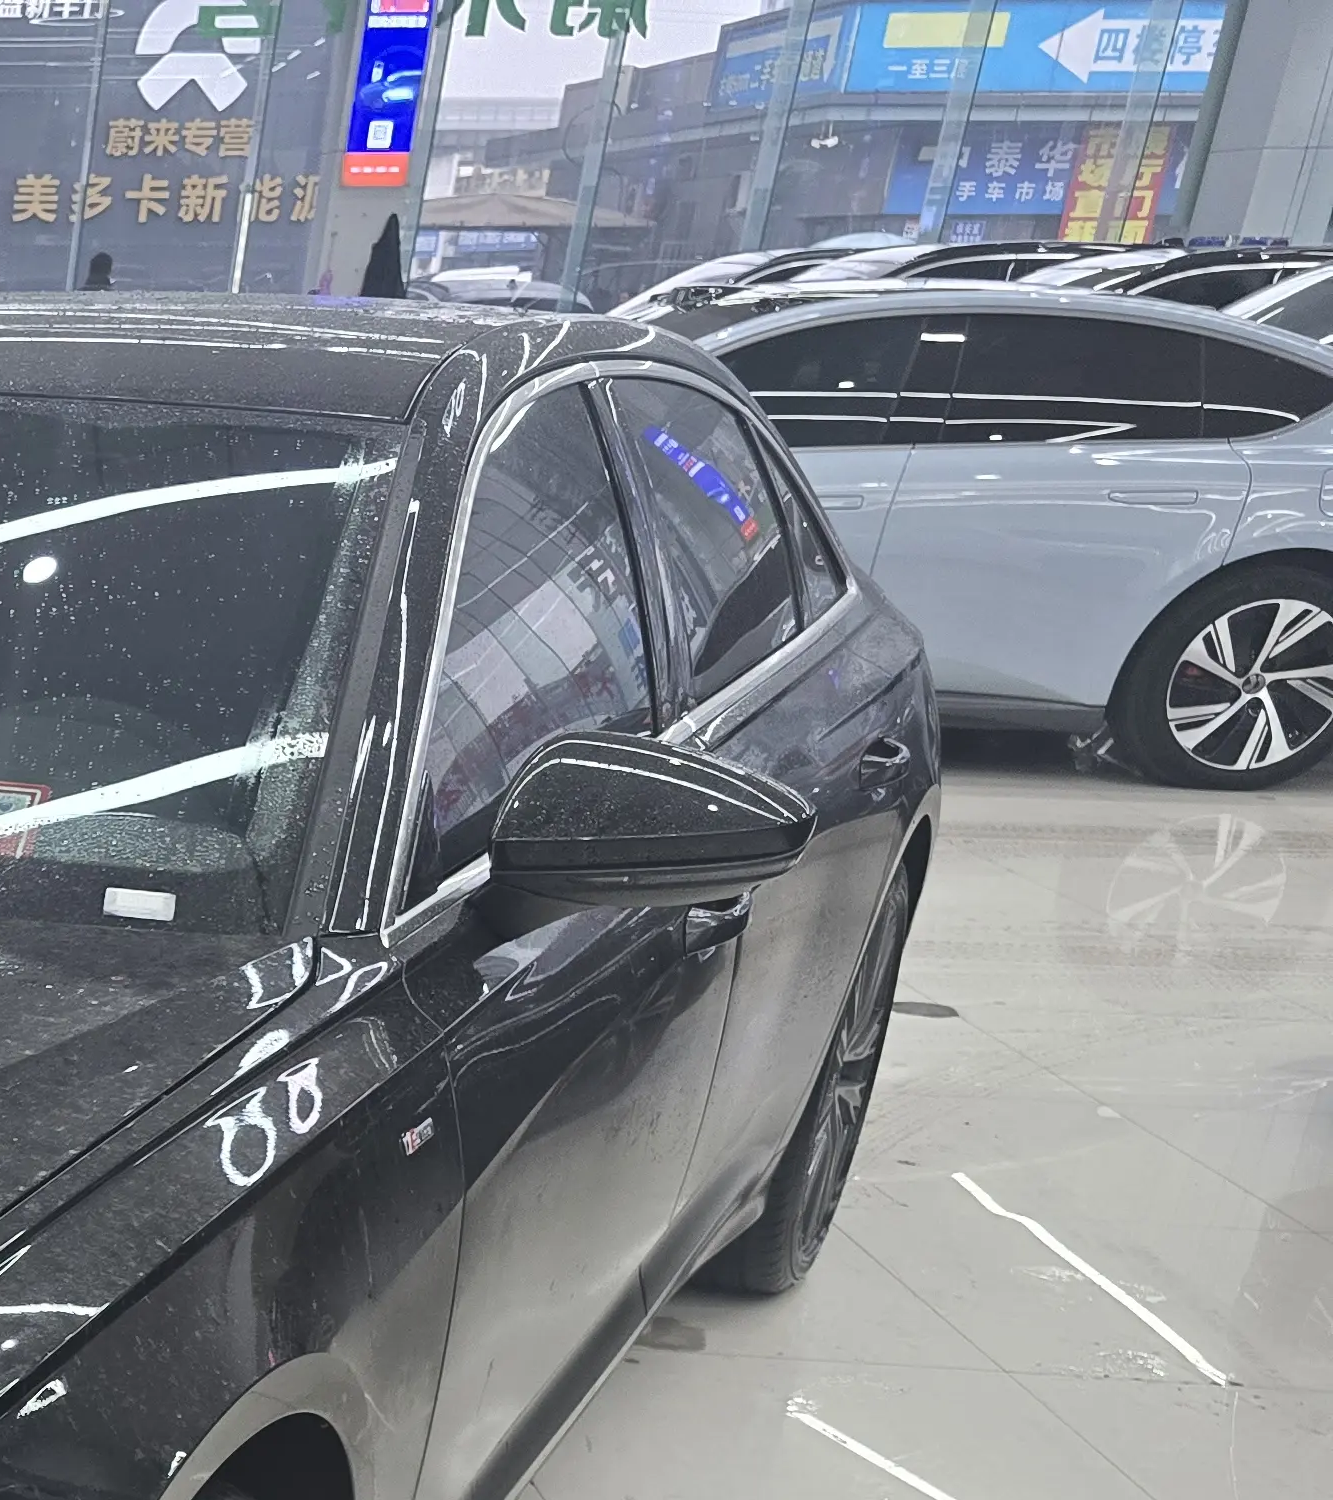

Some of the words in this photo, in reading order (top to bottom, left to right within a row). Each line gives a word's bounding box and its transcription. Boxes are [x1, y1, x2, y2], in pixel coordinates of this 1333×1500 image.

[1093, 25, 1222, 66] 四楼停
[105, 118, 256, 157] 蔚来专营
